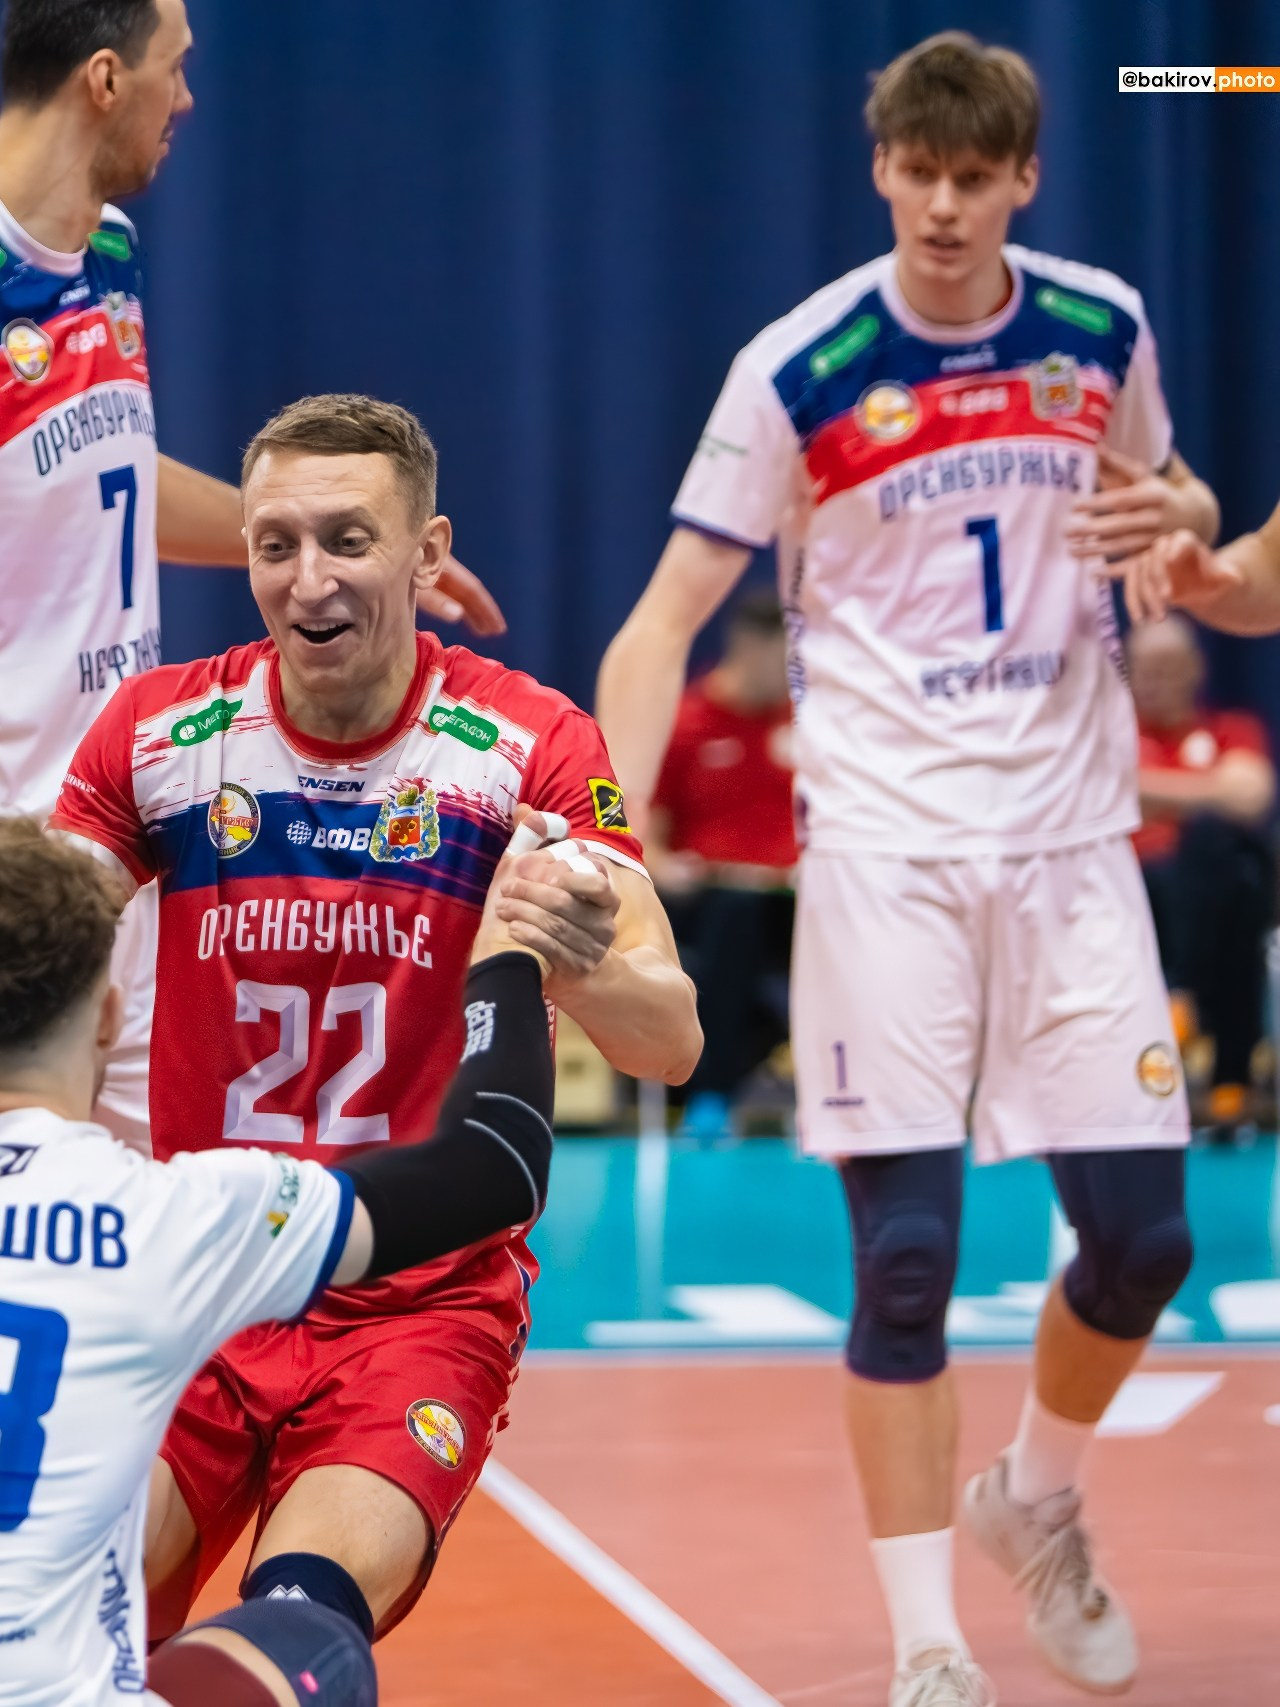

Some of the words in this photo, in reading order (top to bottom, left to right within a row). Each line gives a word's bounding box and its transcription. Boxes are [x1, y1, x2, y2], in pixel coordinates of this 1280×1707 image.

[31, 388, 156, 477] ОРЕНБУРЖЬ
[98, 463, 137, 611] 7
[965, 514, 1004, 633] 1
[445, 713, 492, 743] ЕГАФОН
[298, 775, 365, 793] ENSEN
[311, 826, 372, 851] ВФВ
[198, 898, 433, 969] ОРЕНБУЖЬЕ
[222, 978, 391, 1145] 22
